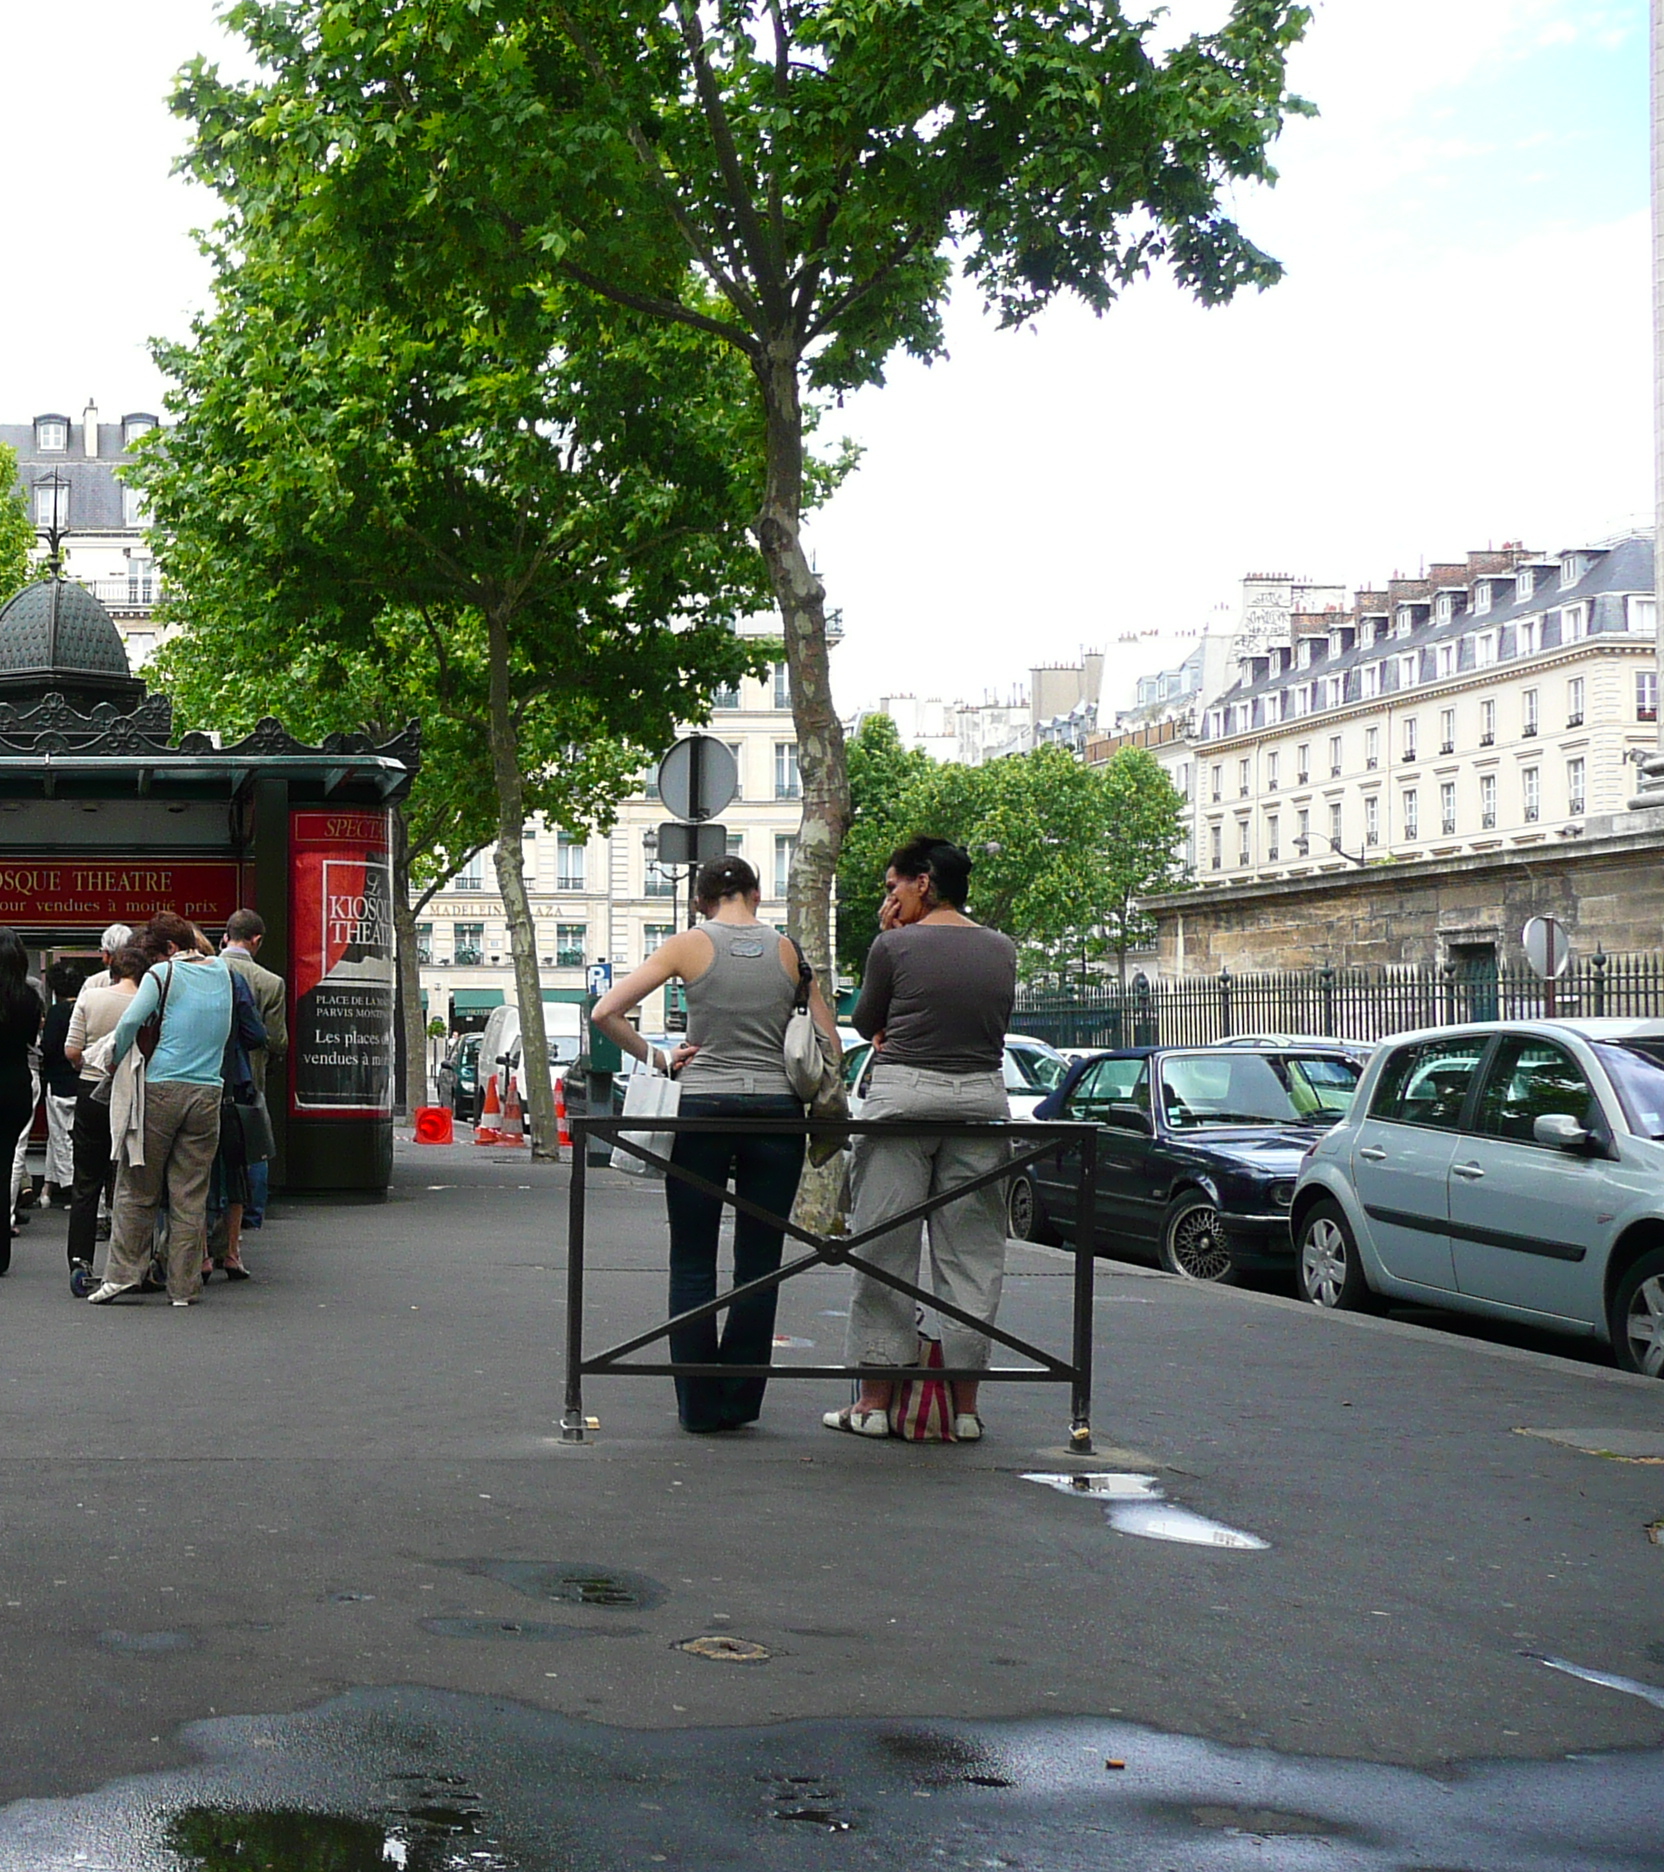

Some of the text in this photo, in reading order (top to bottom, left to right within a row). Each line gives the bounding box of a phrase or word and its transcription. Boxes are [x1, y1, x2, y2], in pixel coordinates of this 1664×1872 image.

[72, 870, 173, 892] THEATRE
[36, 899, 100, 912] vendues
[108, 899, 116, 912] à
[126, 899, 175, 912] moitié
[185, 900, 218, 916] prix
[316, 995, 350, 1005] PLACE
[351, 996, 364, 1005] DE
[316, 1007, 353, 1018] PARVIS
[315, 1029, 340, 1044] Les
[345, 1030, 380, 1048] places
[302, 1051, 359, 1065] vendues
[362, 1051, 369, 1065] à
